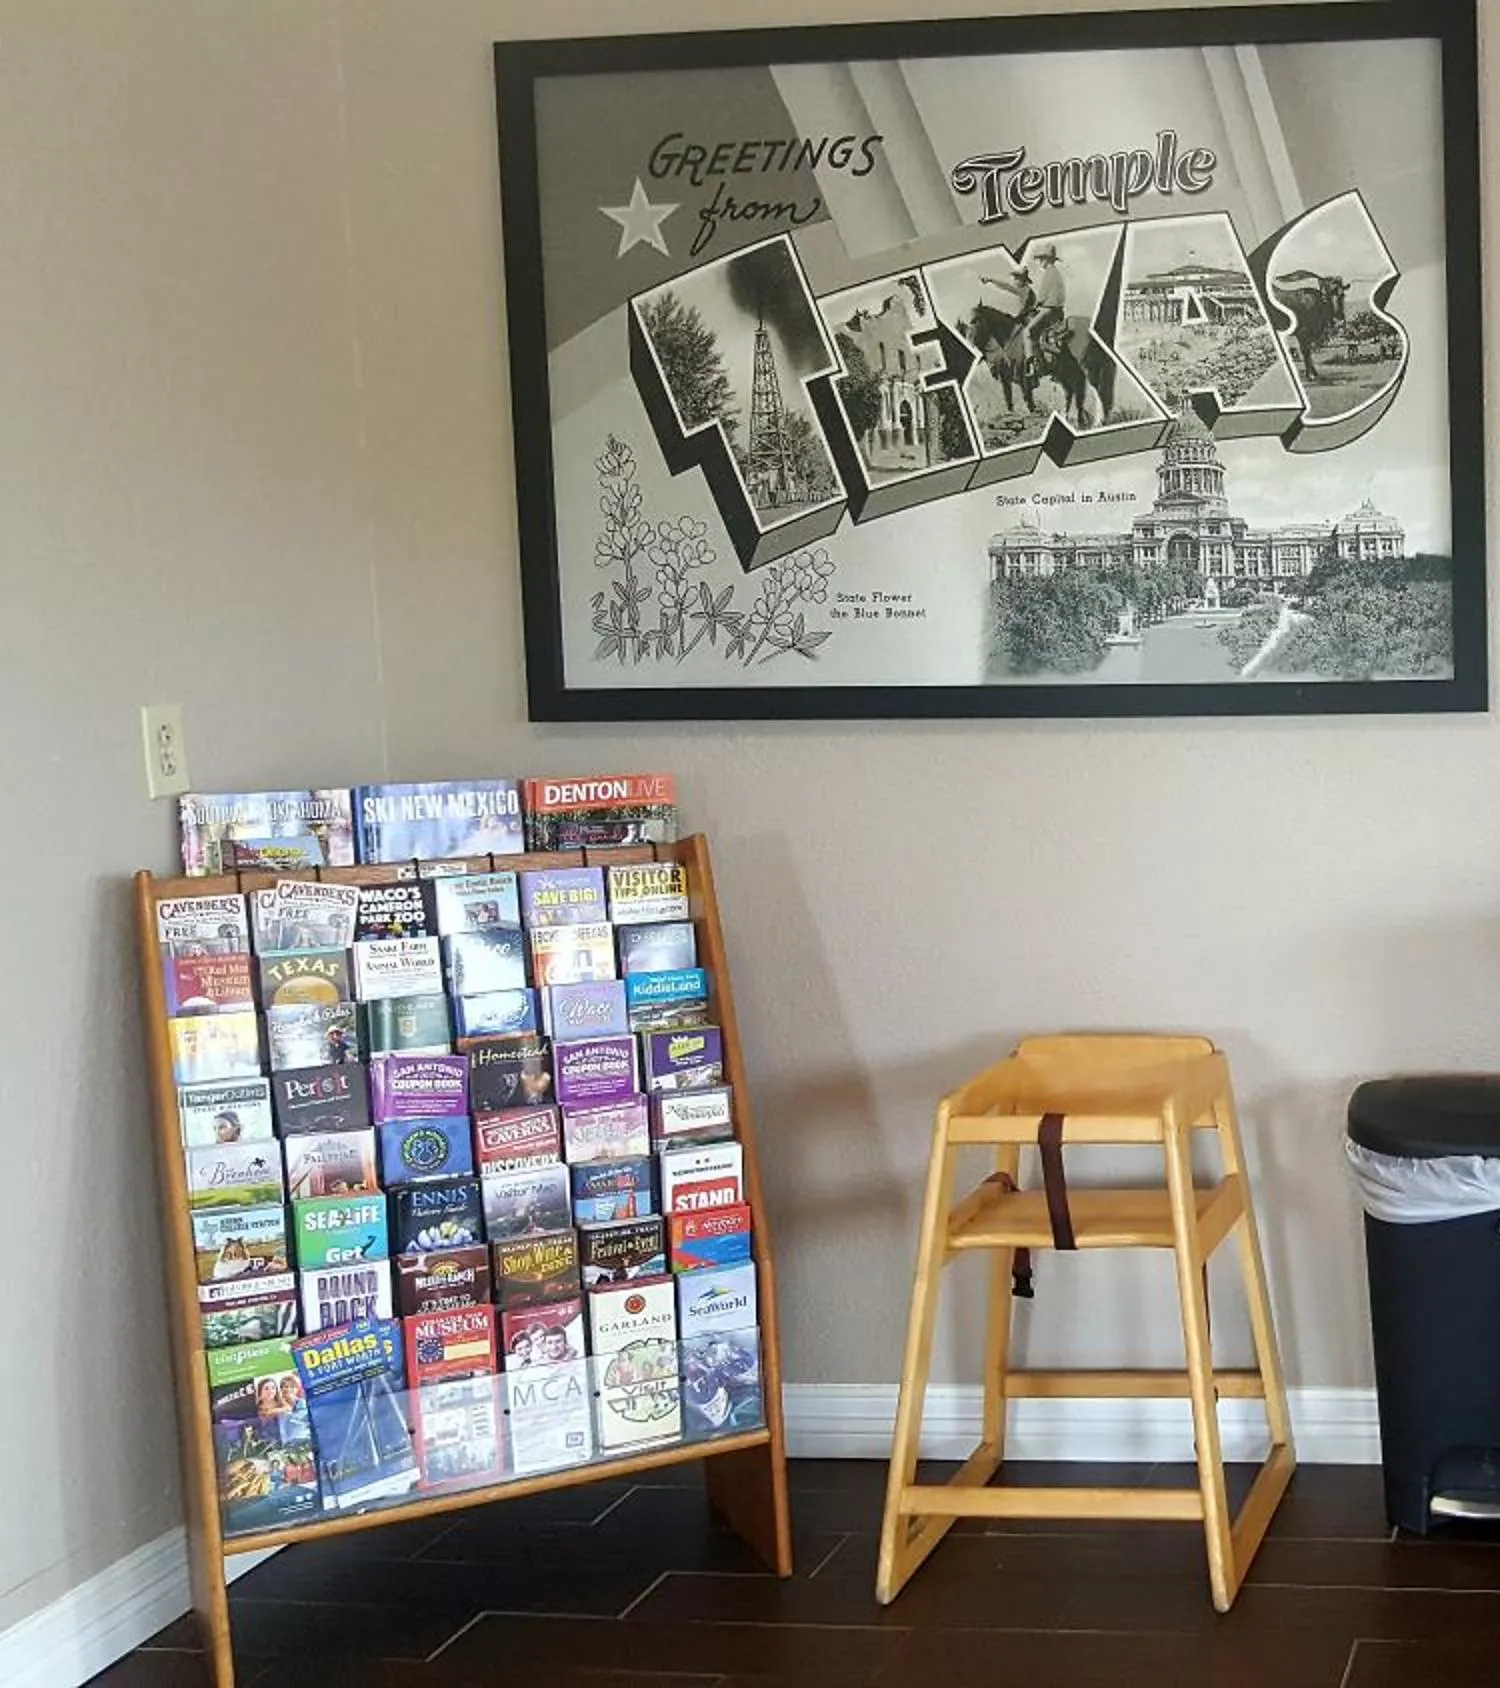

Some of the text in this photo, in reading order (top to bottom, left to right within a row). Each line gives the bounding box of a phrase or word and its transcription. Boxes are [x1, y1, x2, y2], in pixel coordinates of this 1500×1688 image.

[648, 131, 884, 187] GREETINGS
[951, 128, 1219, 226] Temple
[690, 182, 822, 257] from
[629, 188, 1411, 573] TEXAS
[996, 494, 1027, 507] State
[1081, 493, 1094, 504] in
[1098, 491, 1138, 504] Austin
[836, 591, 913, 602] State Flower
[829, 607, 927, 619] the Blue Bonnet
[543, 778, 665, 805] DENTON LIVE
[363, 789, 519, 823] SKI NEW MEXICO
[613, 868, 682, 888] VISITOR
[359, 886, 422, 902] WACO'S
[614, 883, 683, 899] TIPS ONLINE
[159, 897, 241, 920] CAVENDER'S
[359, 901, 423, 914] CAMERON
[359, 911, 426, 925] PARK ZOO
[165, 927, 198, 939] FREE
[268, 956, 341, 981] TEXAS
[412, 1185, 468, 1207] ENNIS
[675, 1187, 735, 1212] STAND
[304, 1210, 342, 1231] SEA
[325, 1245, 364, 1264] Get
[317, 1269, 379, 1299] ROUND
[688, 1296, 748, 1318] SeaWorld
[415, 1315, 489, 1338] MUSEUM
[599, 1313, 673, 1334] GARLAND
[303, 1333, 378, 1370] Dallas
